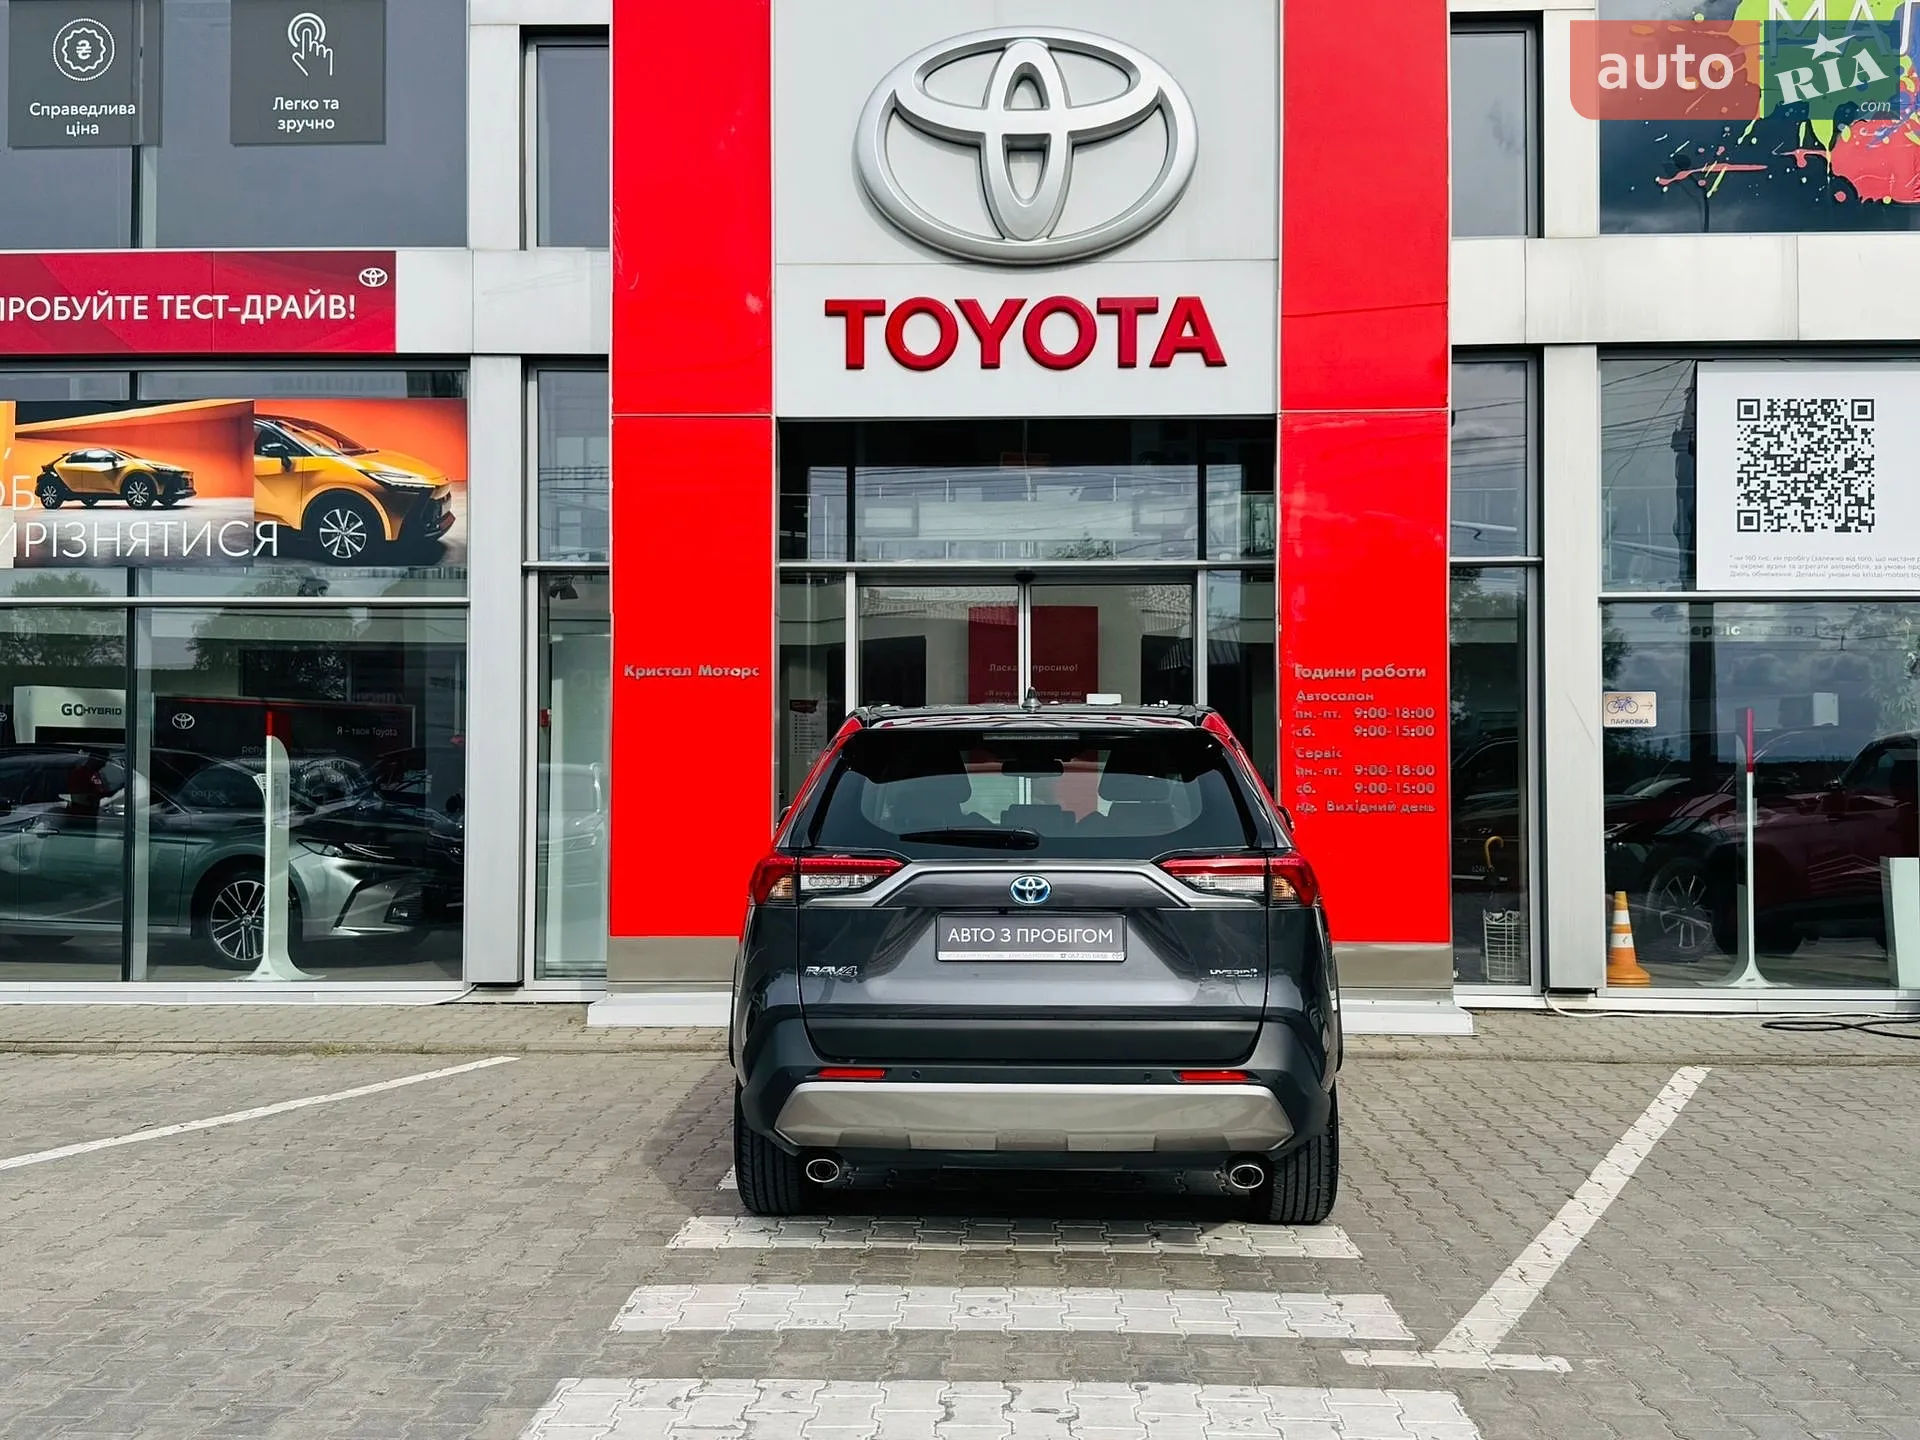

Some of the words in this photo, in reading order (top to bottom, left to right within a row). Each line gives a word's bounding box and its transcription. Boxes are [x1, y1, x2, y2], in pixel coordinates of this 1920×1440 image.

[29, 102, 136, 119] Справедлива
[272, 96, 319, 111] Легко
[322, 99, 340, 110] та
[66, 121, 100, 137] ціна
[277, 118, 335, 133] зручно
[0, 289, 149, 322] РОБУЙТЕ
[157, 288, 356, 325] ТЕСТ-ДРАЙВ!
[824, 296, 1227, 371] TOYOTA
[623, 664, 692, 680] Кристал
[698, 664, 760, 680] Моторс
[1294, 663, 1357, 679] Години
[1361, 663, 1427, 682] роботи
[1295, 690, 1375, 702] Автосалон
[1295, 724, 1316, 737] сб.
[1295, 746, 1343, 760] Сервіс
[1295, 781, 1317, 794] сб.
[1295, 801, 1317, 813] нд.
[1326, 800, 1396, 813] Вихідний
[1401, 802, 1436, 813] день
[947, 927, 996, 944] АВТО
[1016, 927, 1114, 944] ПРОБІГОМ
[804, 965, 858, 978] RAV4
